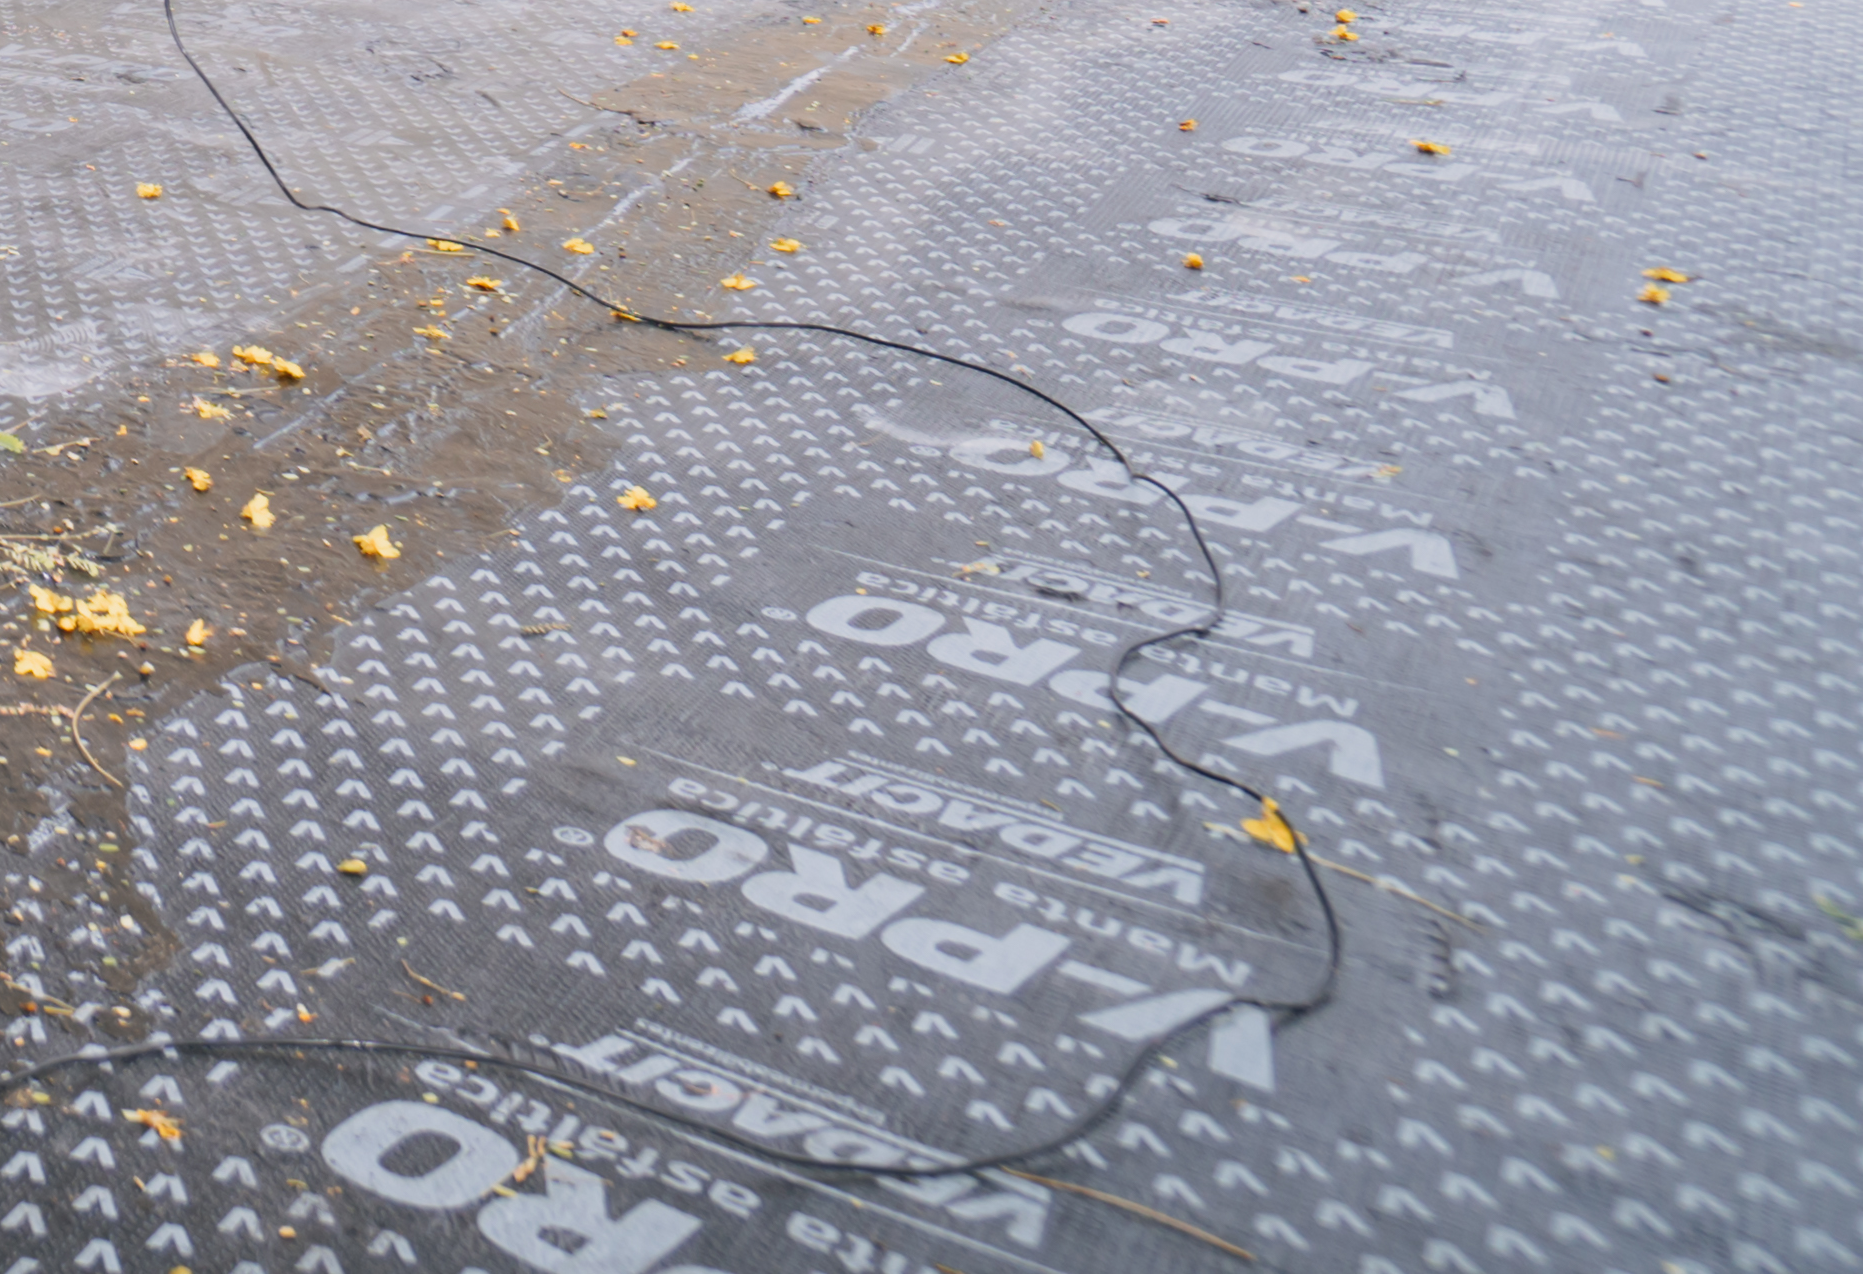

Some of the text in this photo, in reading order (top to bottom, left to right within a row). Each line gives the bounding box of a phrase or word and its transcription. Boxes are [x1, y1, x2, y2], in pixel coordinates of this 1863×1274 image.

[1147, 217, 1561, 301] V-PRO
[1061, 312, 1518, 421] V-PRO
[949, 437, 1460, 580] V-PRO
[1240, 473, 1435, 527] Manta
[855, 570, 1121, 645] asfáltica
[805, 593, 1386, 791] V-PRO
[1138, 643, 1360, 718] Manta
[667, 777, 973, 885] asfáltica
[782, 753, 1206, 907] VEDACIT
[603, 808, 1275, 1094] V-PRO
[993, 881, 1255, 990] Manta
[414, 1057, 763, 1219] asfáltica
[553, 1031, 1054, 1250] VEDACIT
